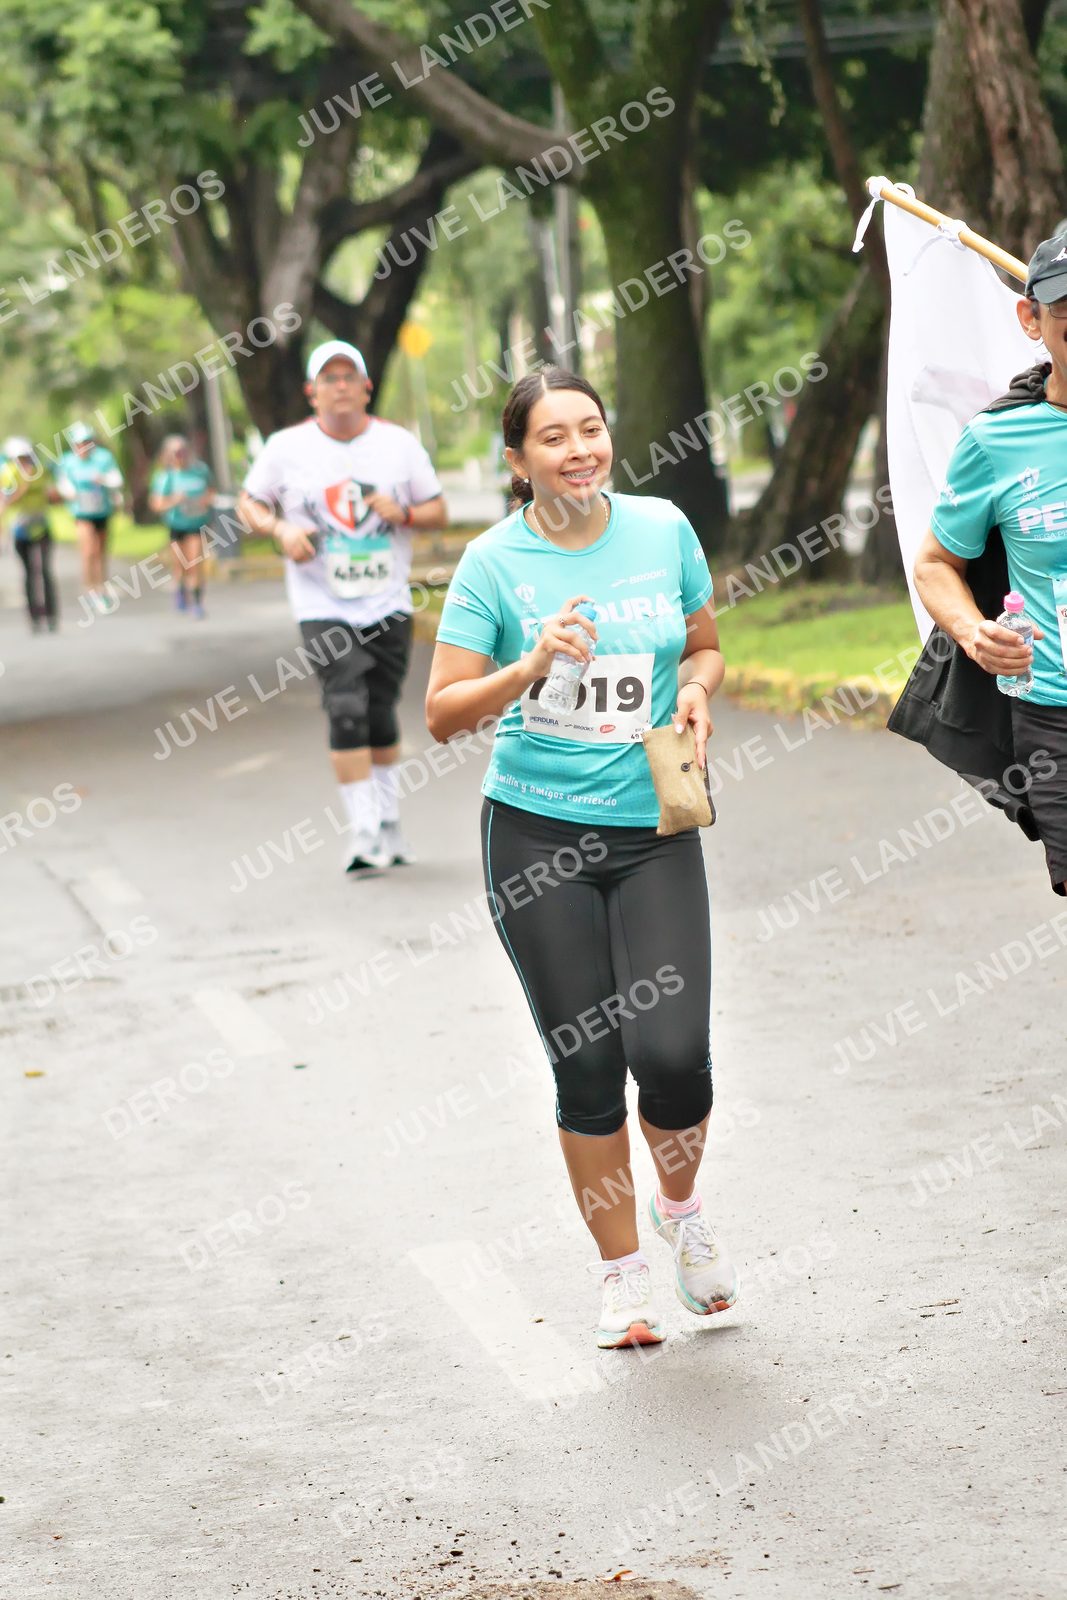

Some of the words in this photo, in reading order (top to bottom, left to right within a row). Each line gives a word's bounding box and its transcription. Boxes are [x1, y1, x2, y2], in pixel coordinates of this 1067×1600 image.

[1017, 501, 1067, 534] PE
[335, 563, 388, 582] 4545
[629, 568, 668, 584] BROOKS
[521, 783, 527, 793] y
[530, 784, 564, 800] amigos
[567, 792, 617, 807] corriendo
